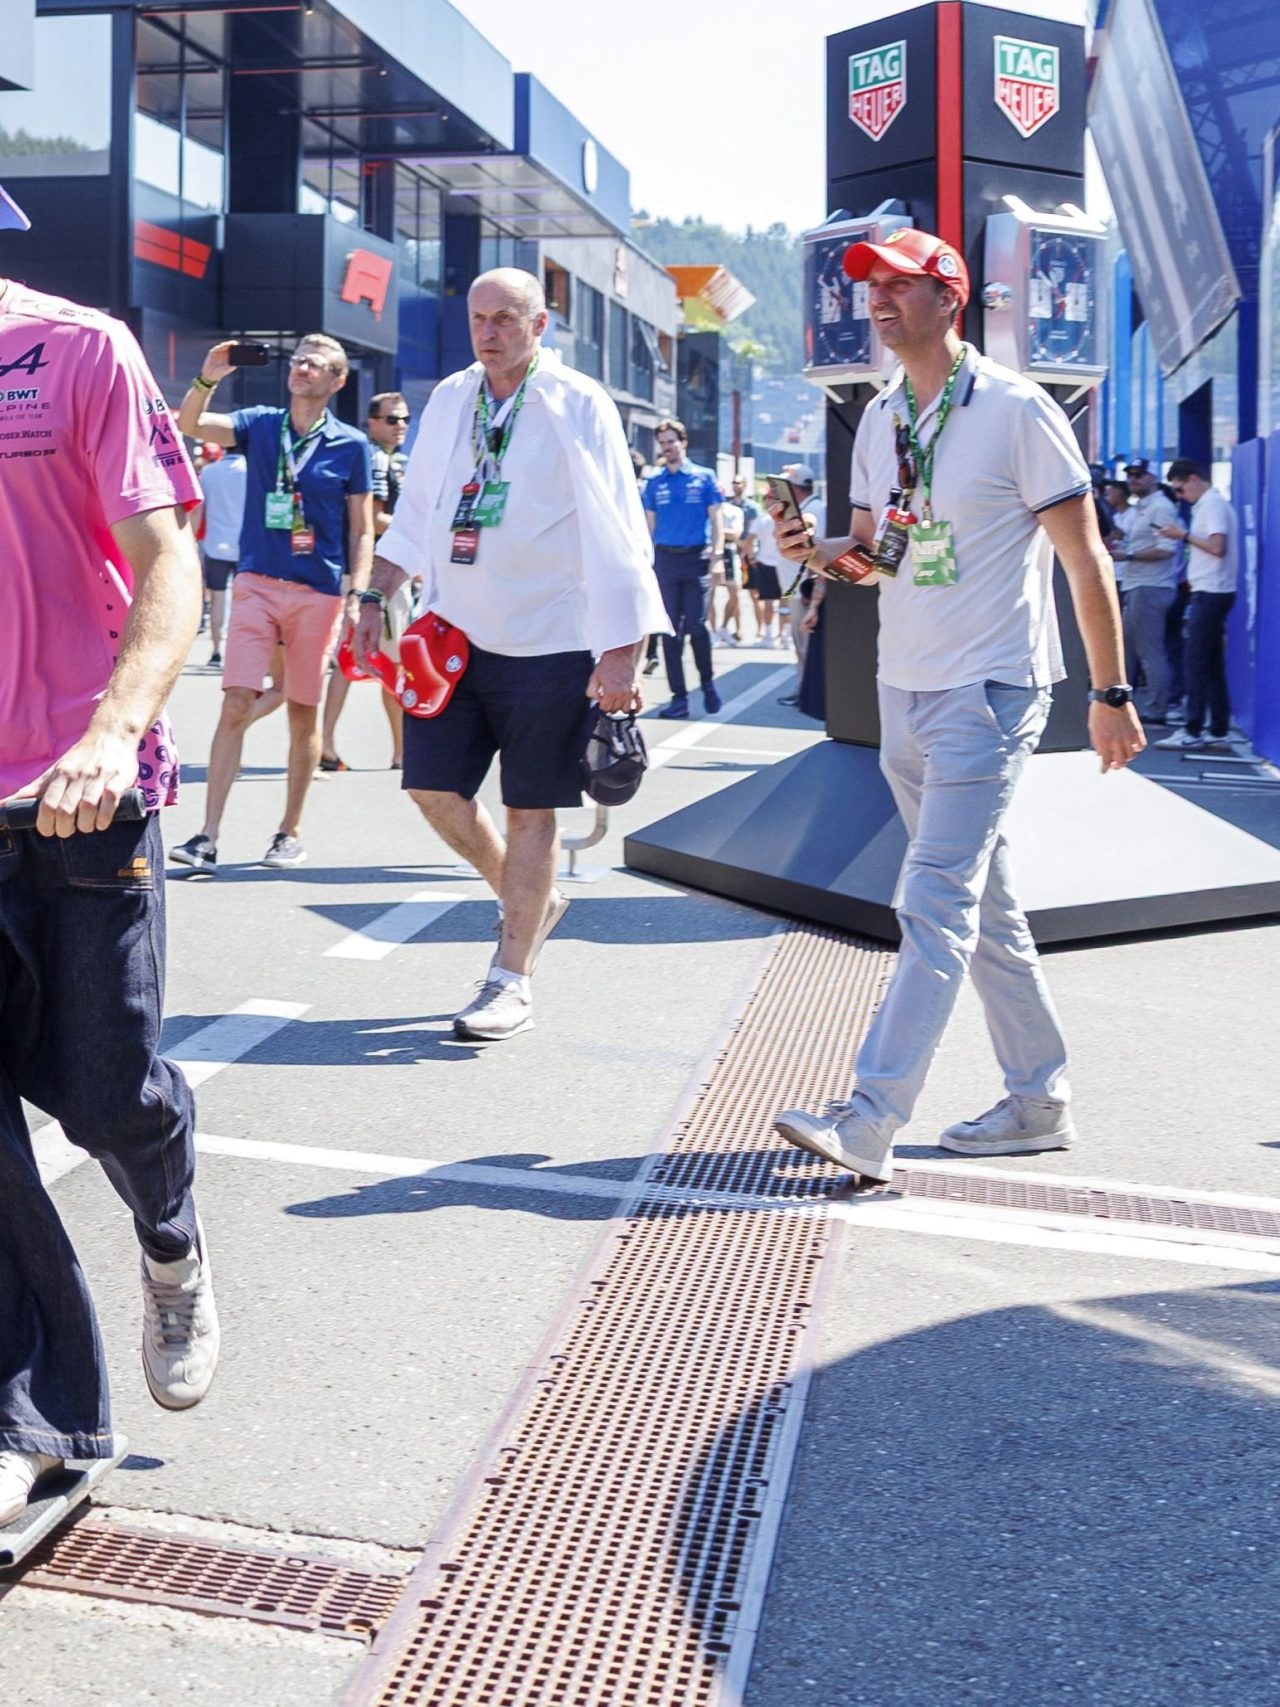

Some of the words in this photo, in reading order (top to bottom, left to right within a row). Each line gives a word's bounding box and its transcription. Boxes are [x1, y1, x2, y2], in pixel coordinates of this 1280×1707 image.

[853, 49, 900, 86] TAG
[1000, 44, 1054, 80] TAG
[850, 83, 903, 131] HEUER
[999, 79, 1055, 127] HEUER
[7, 388, 39, 401] BWT
